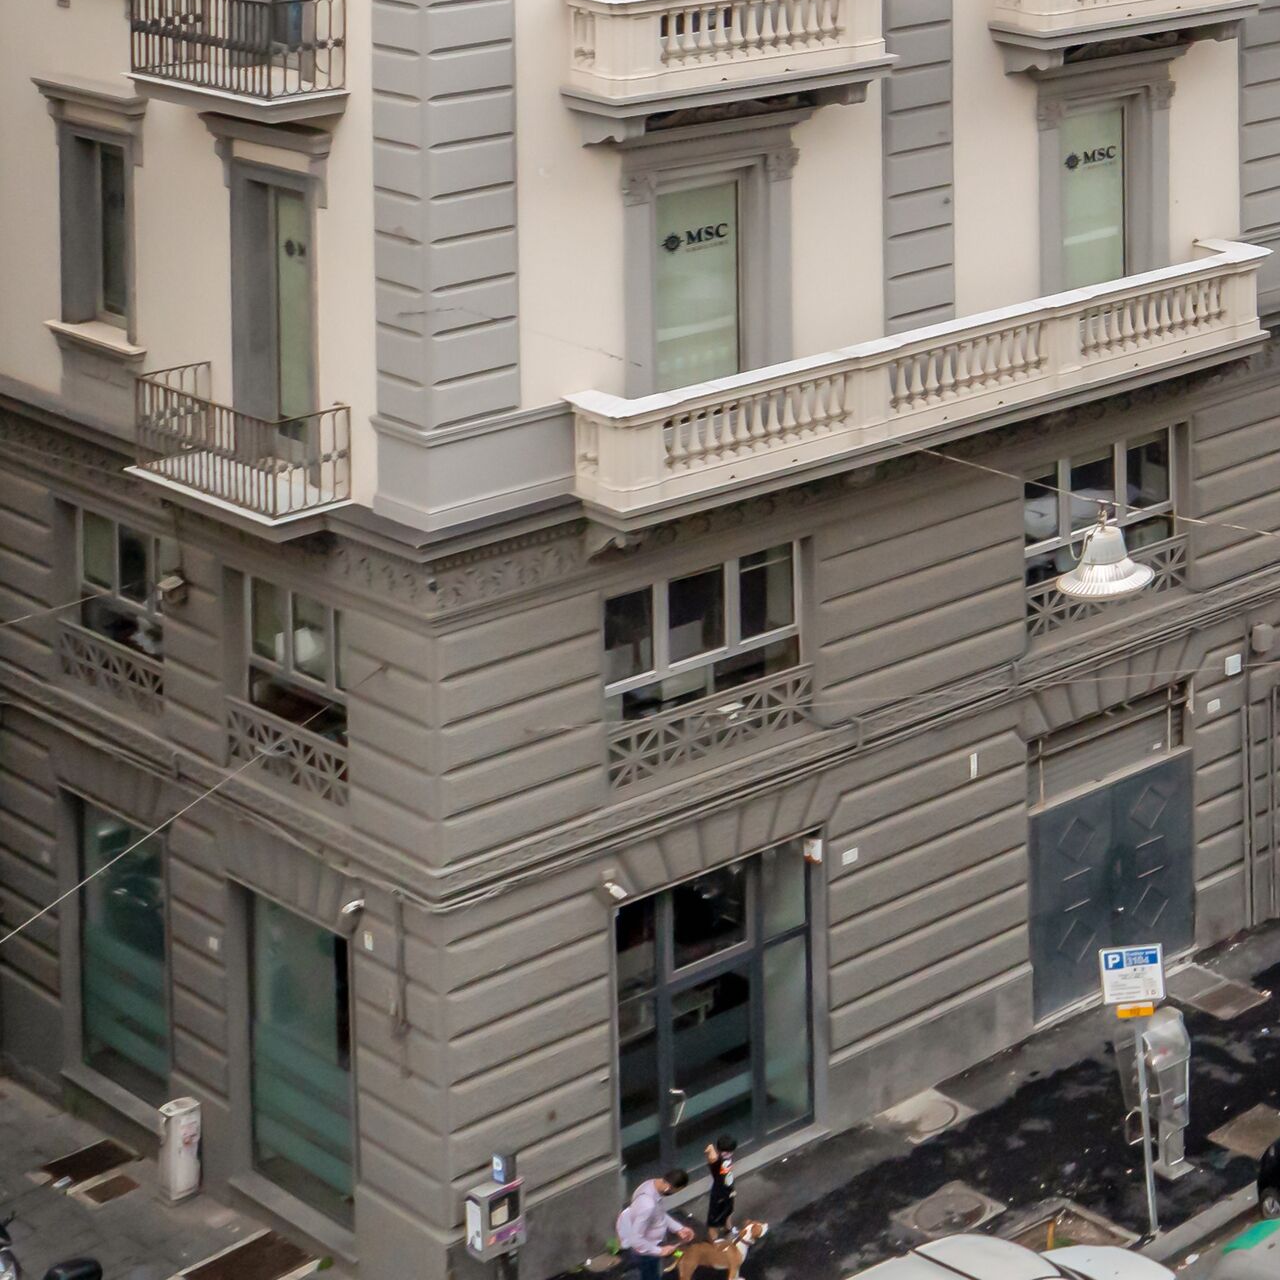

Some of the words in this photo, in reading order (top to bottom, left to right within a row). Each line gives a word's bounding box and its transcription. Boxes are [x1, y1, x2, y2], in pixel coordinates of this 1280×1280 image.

[1083, 145, 1117, 165] MSC
[686, 222, 729, 246] MSC
[1107, 953, 1120, 969] P
